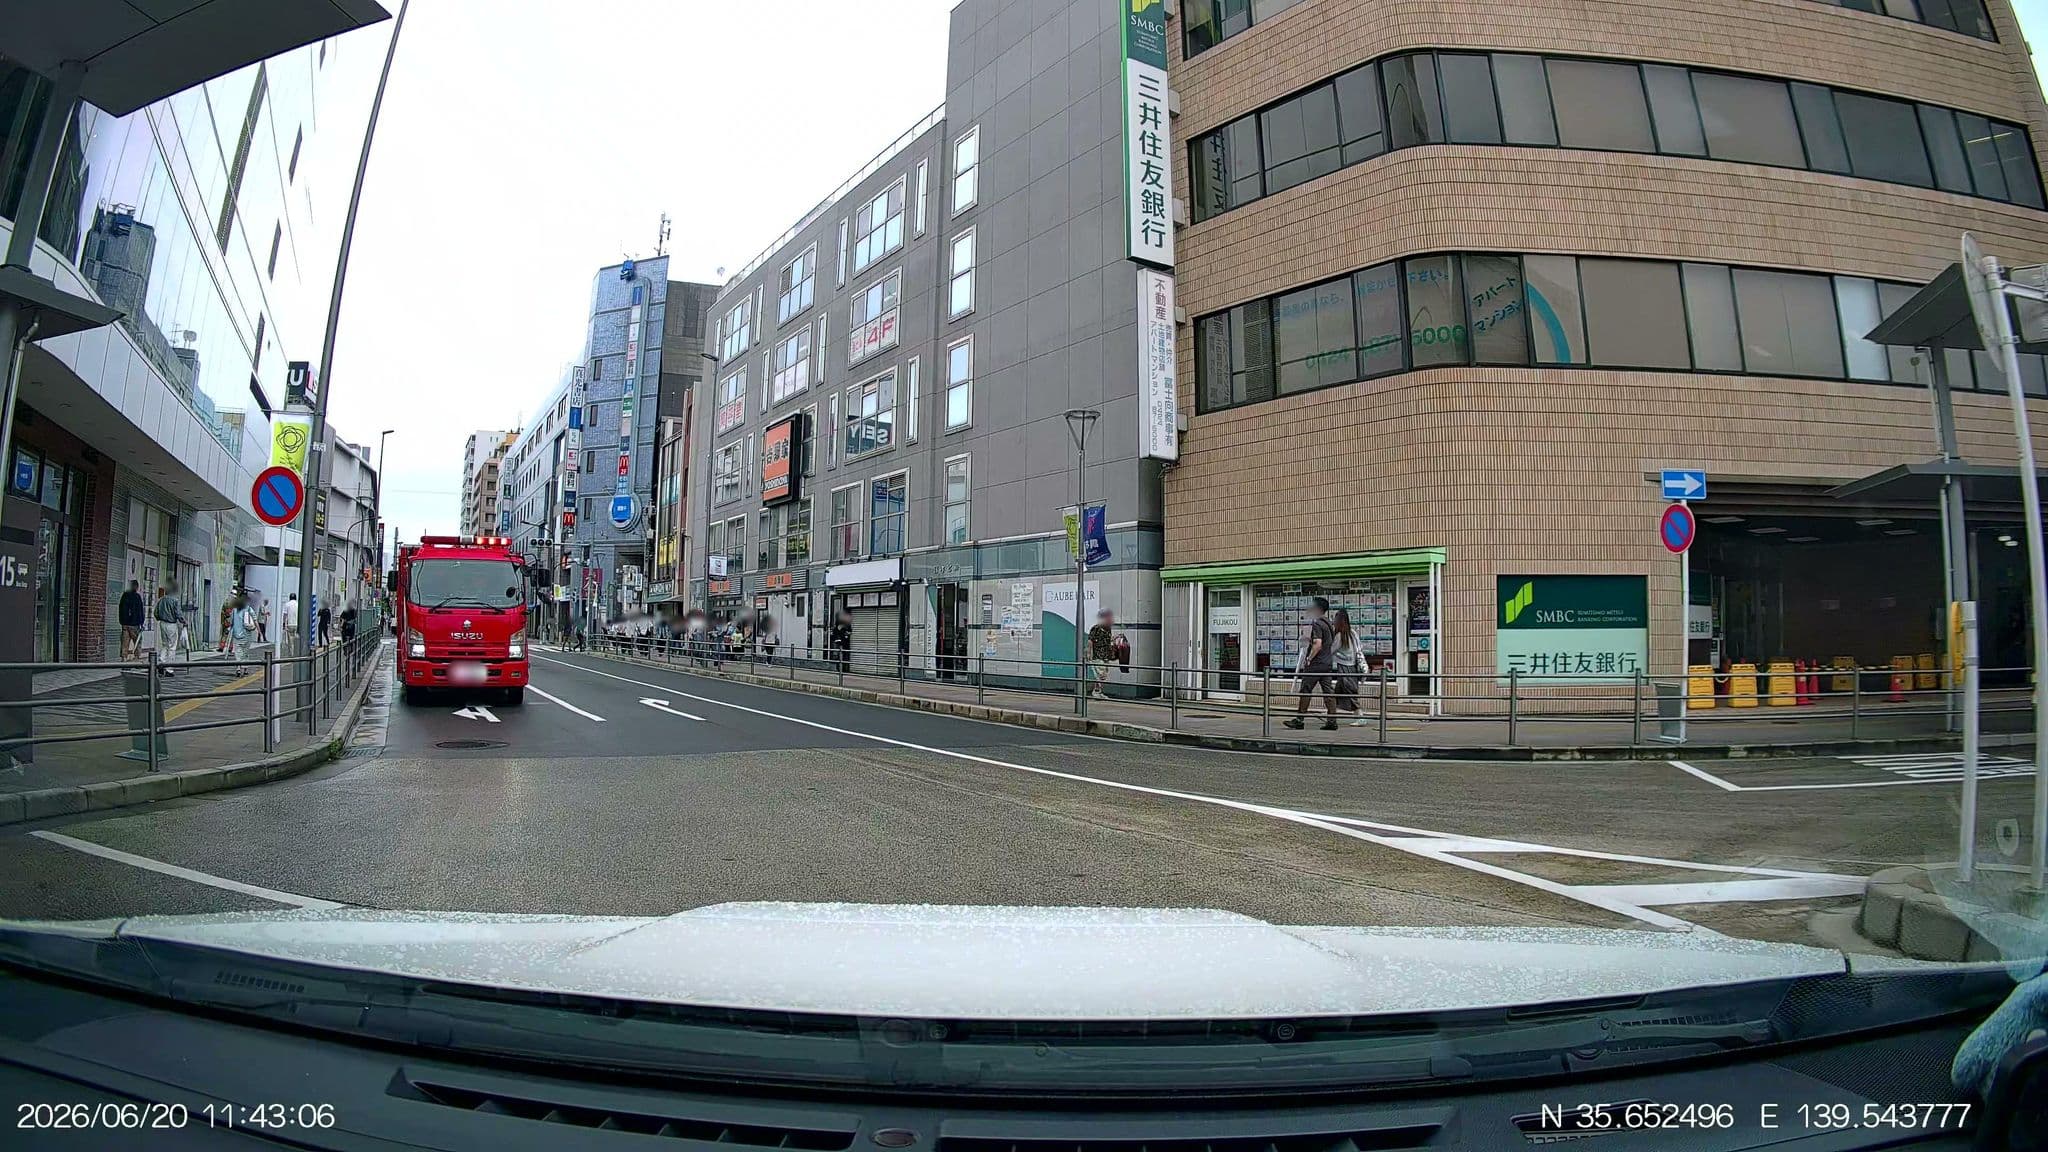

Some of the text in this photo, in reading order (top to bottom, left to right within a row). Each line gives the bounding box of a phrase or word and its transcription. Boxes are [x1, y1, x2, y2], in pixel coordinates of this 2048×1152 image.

[1130, 14, 1164, 36] SMBC
[1138, 74, 1166, 249] 三井住友銀行
[1154, 277, 1167, 321] 不動産
[1472, 276, 1517, 308] アパート
[867, 316, 895, 345] 4F
[0, 555, 16, 587] 15
[1535, 609, 1575, 623] SMBC
[450, 632, 484, 640] ISUZU
[1507, 652, 1638, 674] 三井住友銀行
